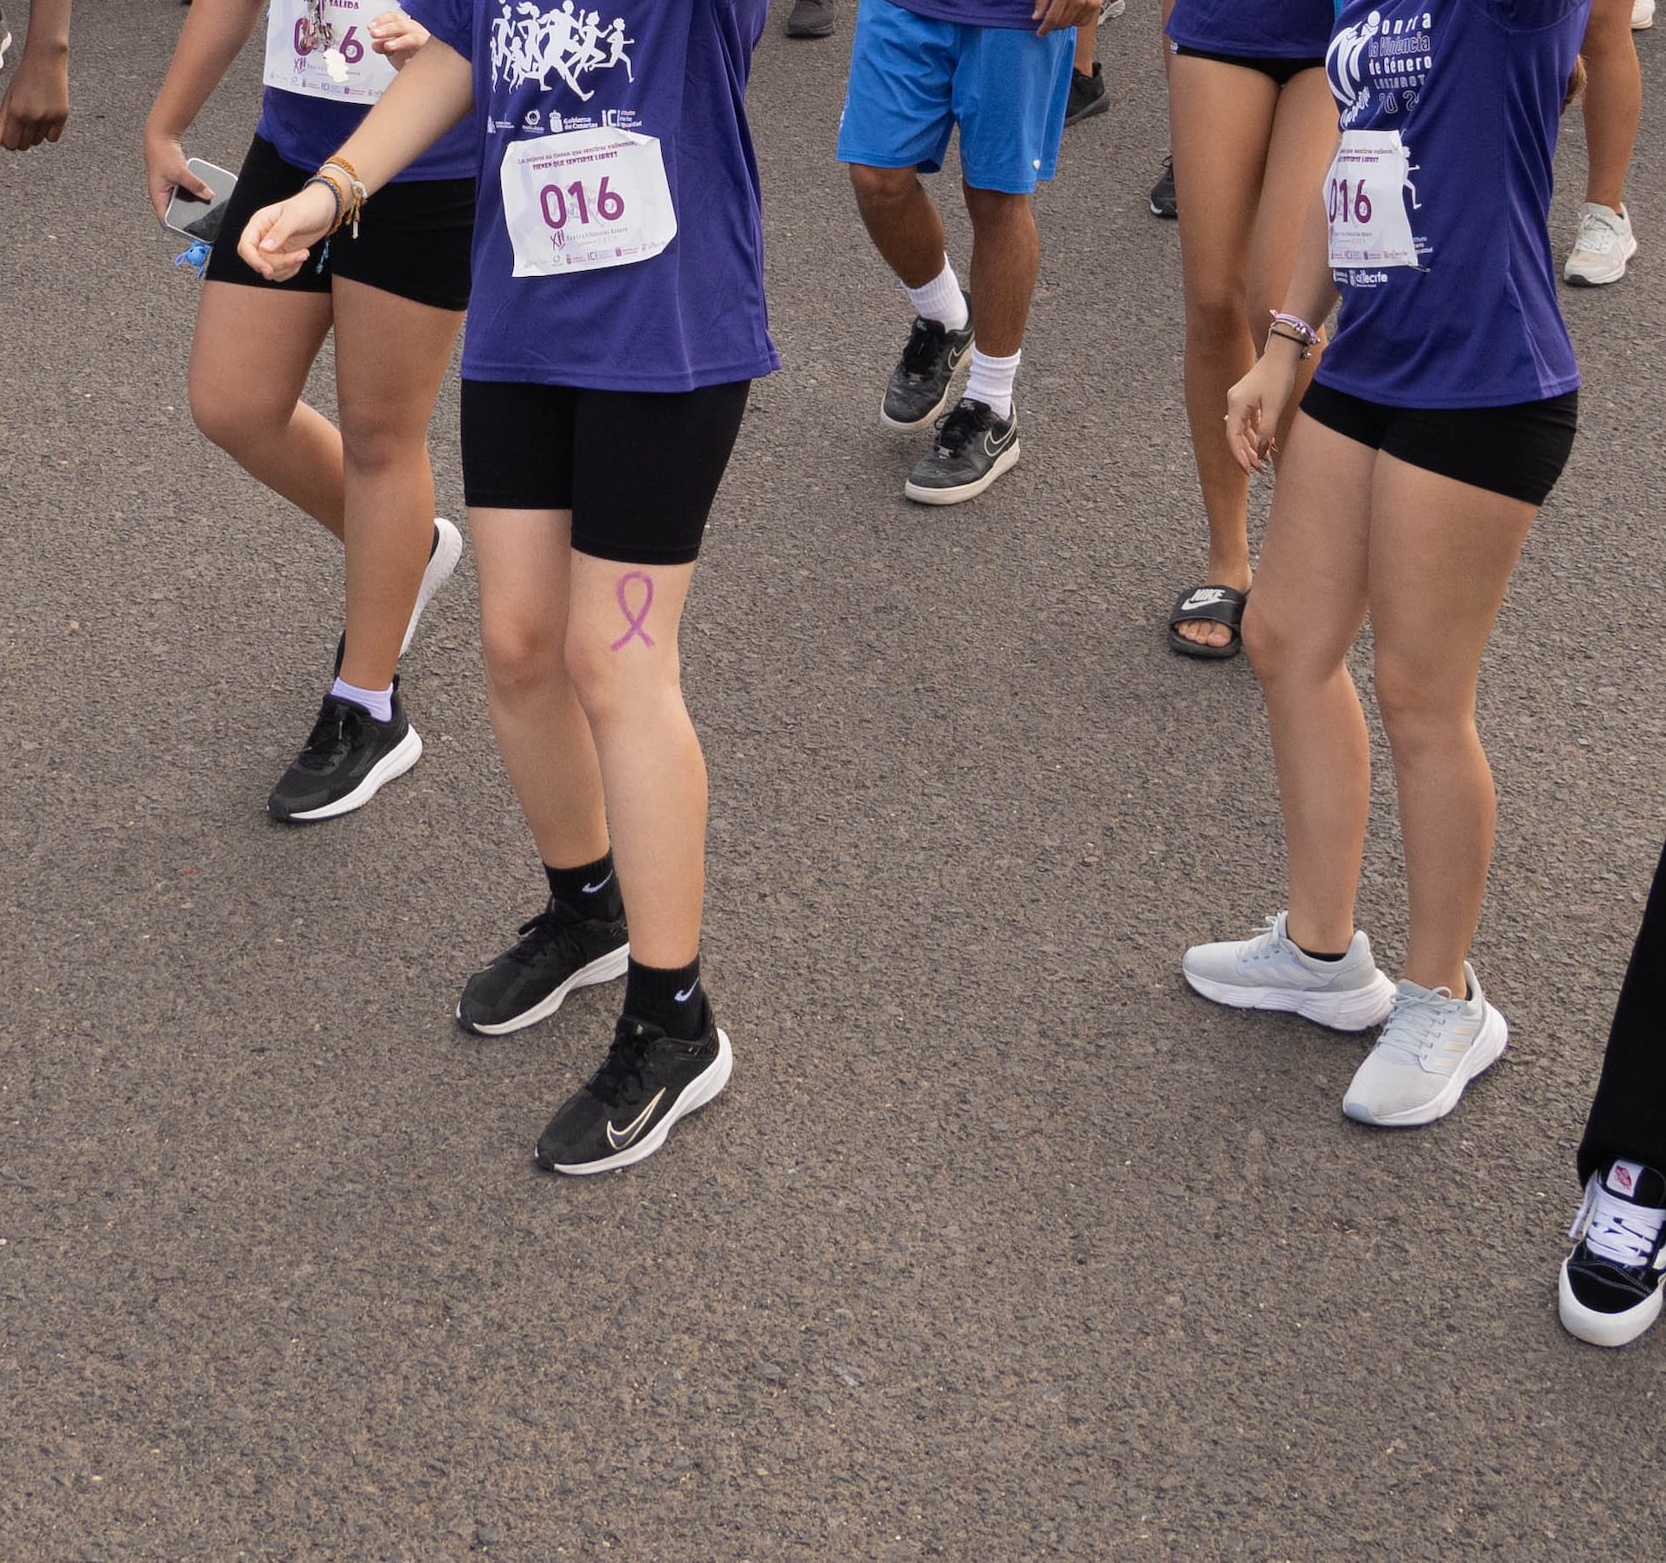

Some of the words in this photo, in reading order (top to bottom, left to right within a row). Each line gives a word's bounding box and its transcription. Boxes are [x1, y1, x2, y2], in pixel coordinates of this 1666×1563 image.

[1369, 59, 1381, 75] de
[1384, 56, 1432, 74] Género
[540, 176, 625, 229] 016
[1329, 178, 1372, 224] 016
